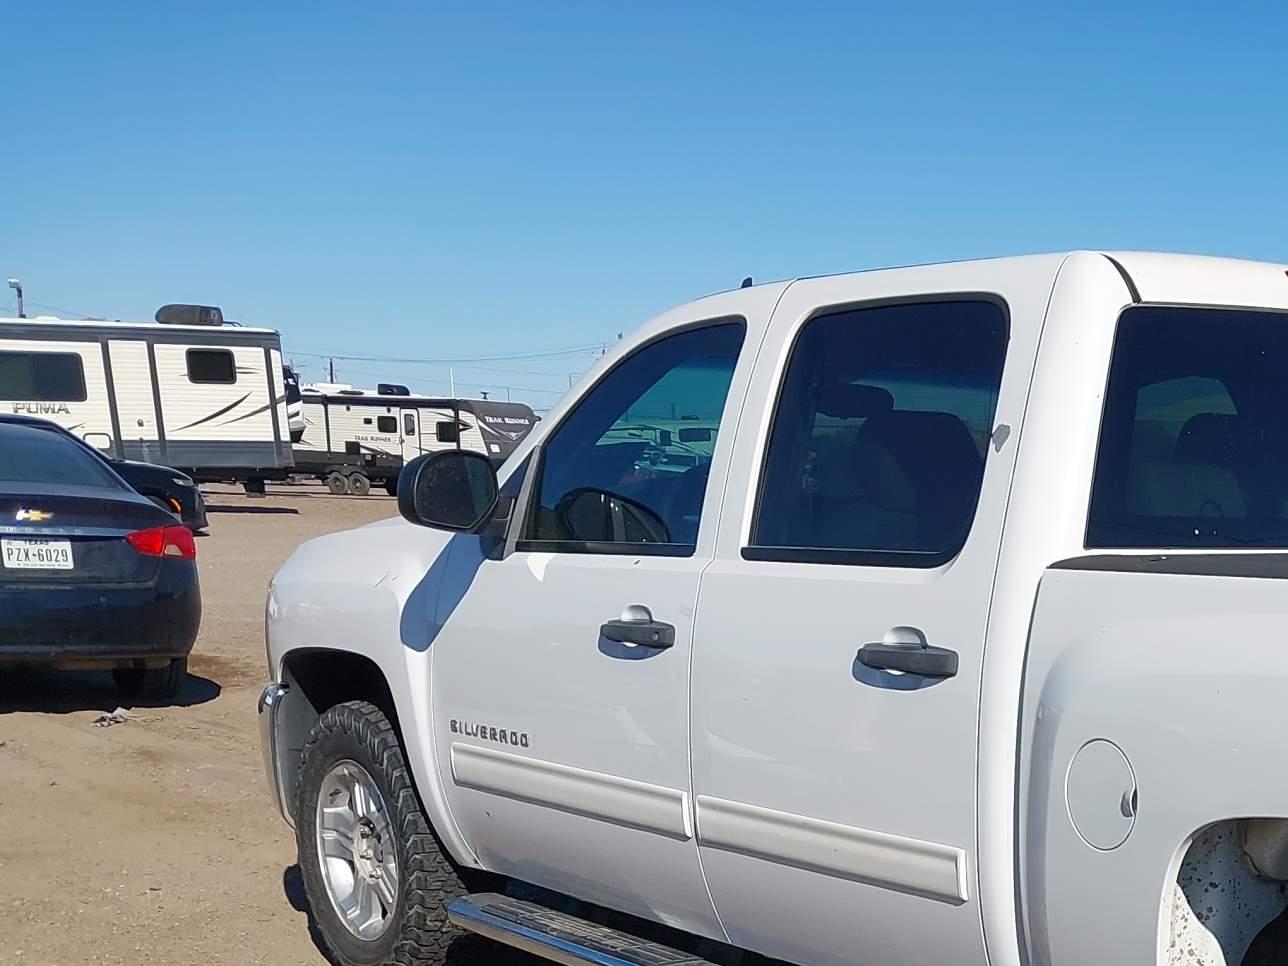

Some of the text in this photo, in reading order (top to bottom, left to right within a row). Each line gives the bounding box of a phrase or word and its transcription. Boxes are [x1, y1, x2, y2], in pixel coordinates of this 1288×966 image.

[12, 402, 71, 415] PUMA
[484, 415, 530, 425] TRAIL RUNNER
[450, 719, 530, 748] SILVERADO
